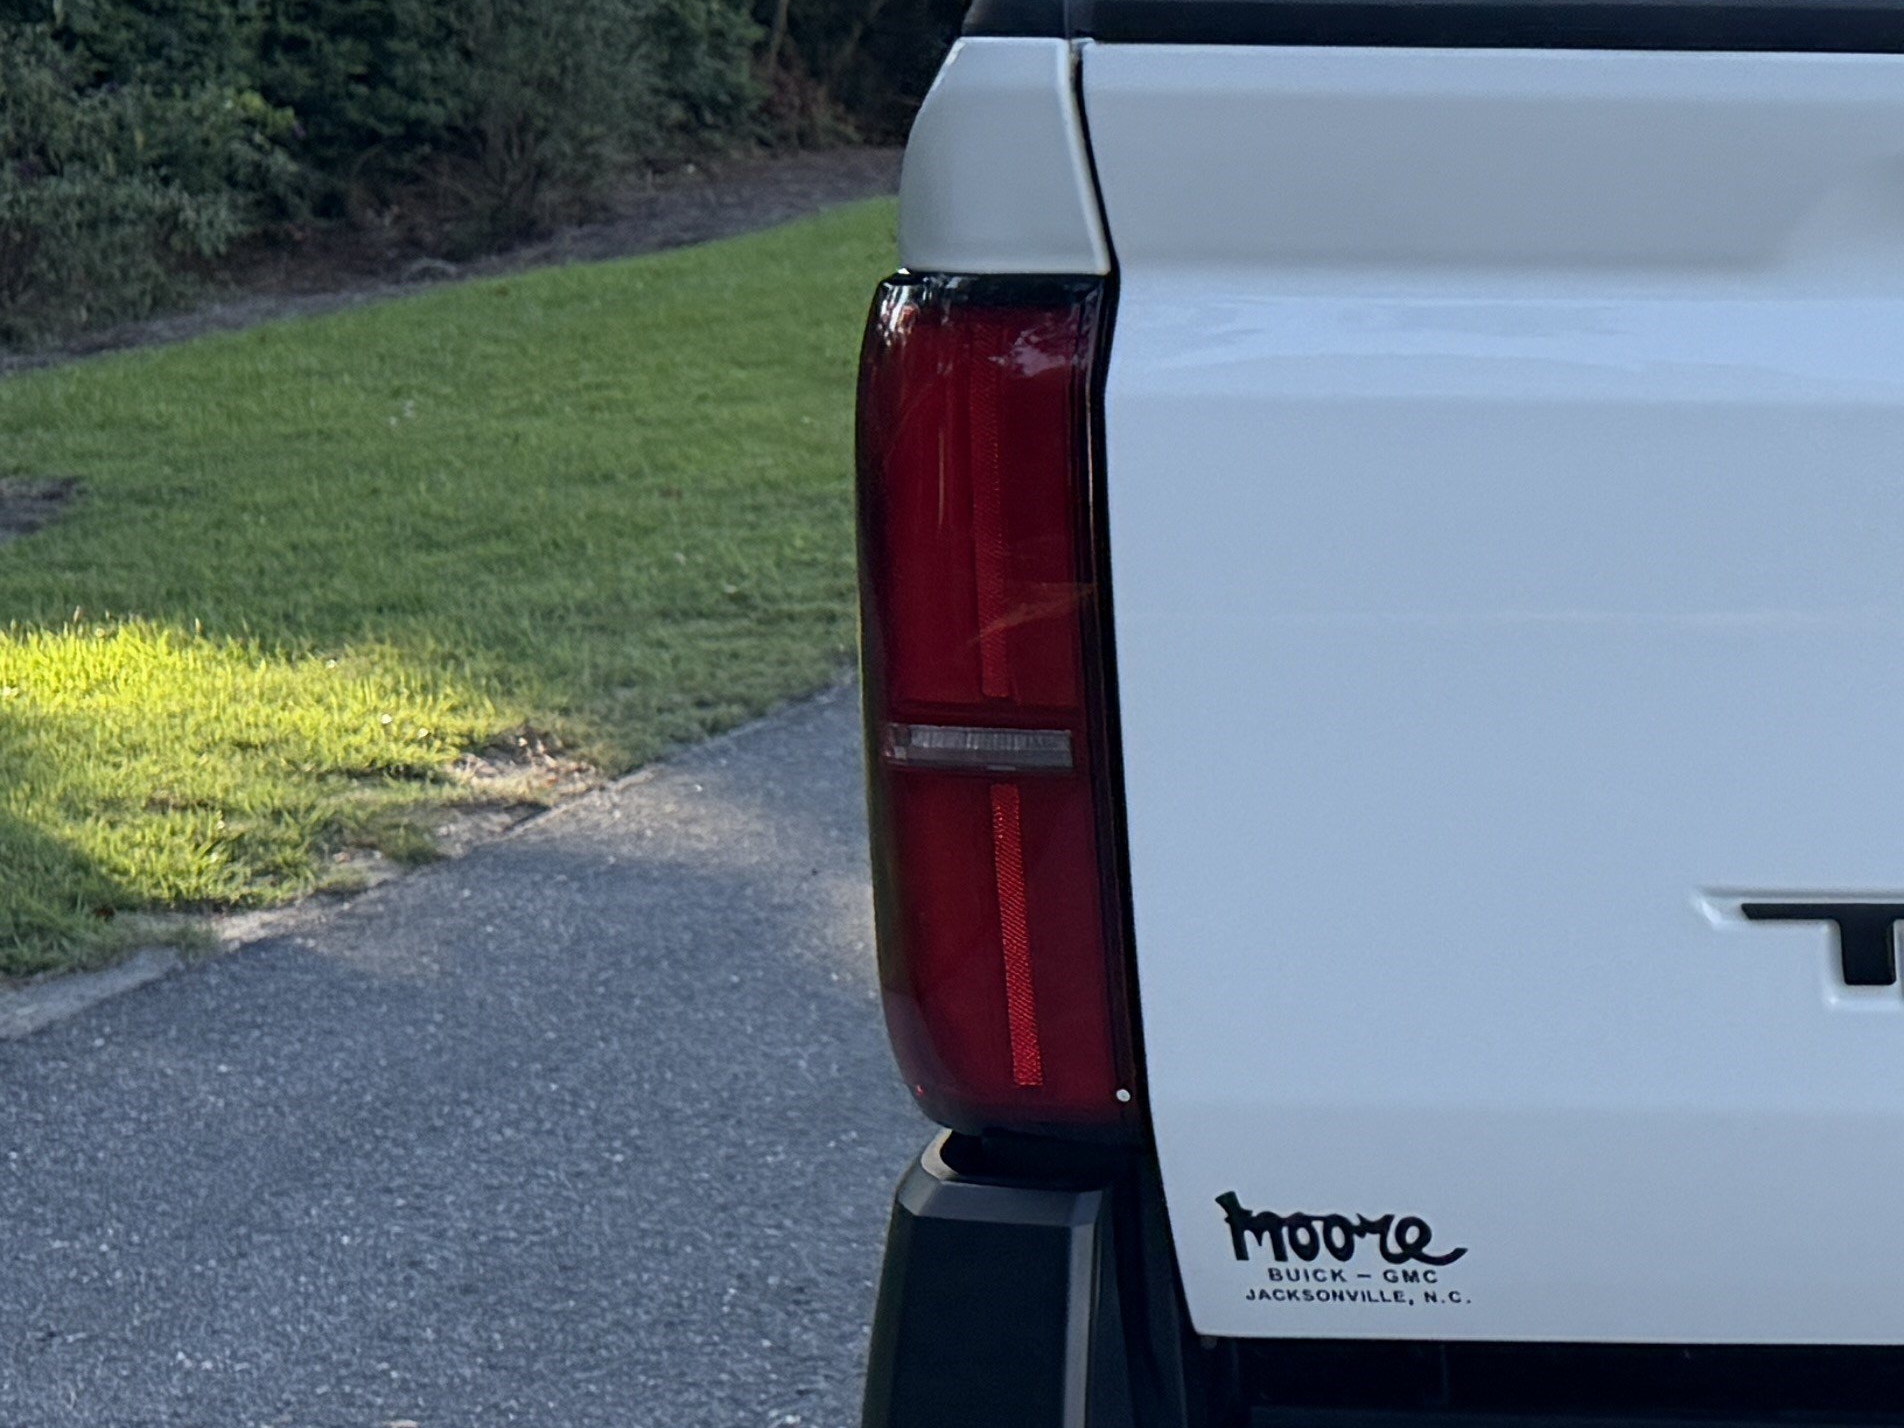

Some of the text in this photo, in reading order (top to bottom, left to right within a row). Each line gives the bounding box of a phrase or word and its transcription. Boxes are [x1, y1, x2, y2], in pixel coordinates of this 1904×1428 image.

[1267, 1267, 1348, 1283] BUICK
[1383, 1269, 1438, 1284] GMC
[1245, 1288, 1414, 1306] JACKSONVILLE,
